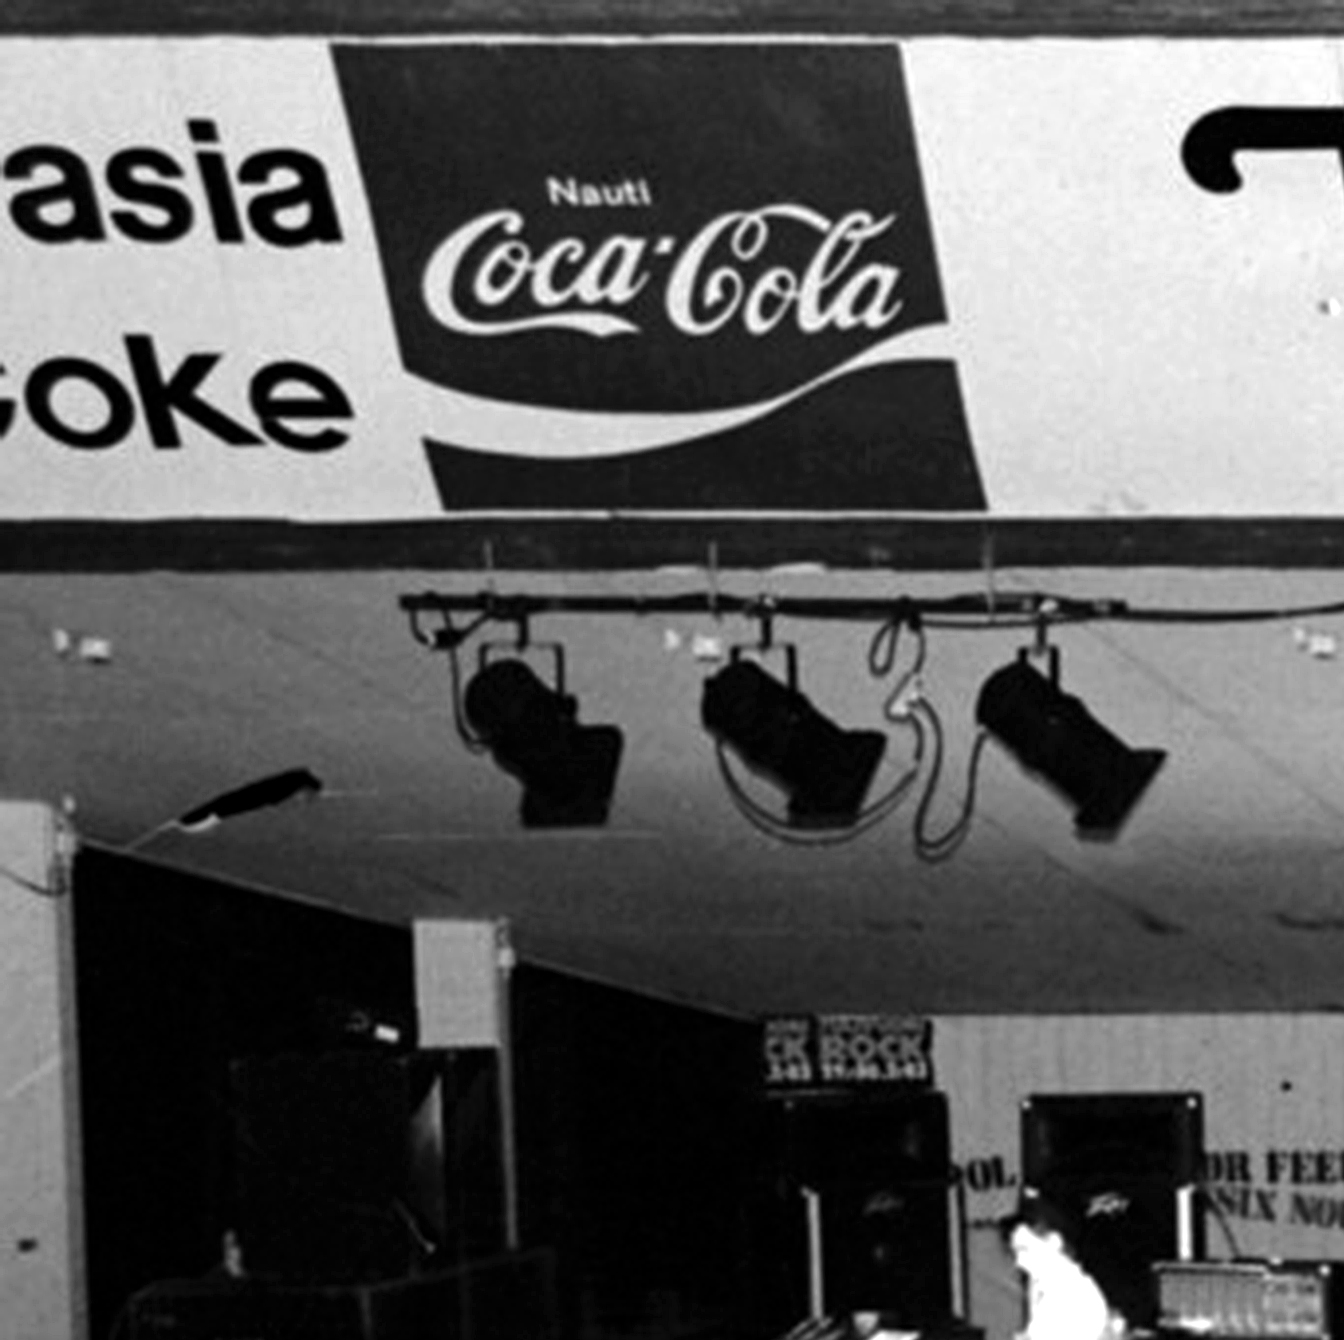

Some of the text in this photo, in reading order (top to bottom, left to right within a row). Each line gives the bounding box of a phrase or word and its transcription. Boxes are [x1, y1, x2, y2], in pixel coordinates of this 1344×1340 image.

[1, 119, 342, 247] asia
[546, 177, 651, 206] Nauti
[0, 334, 354, 452] oke
